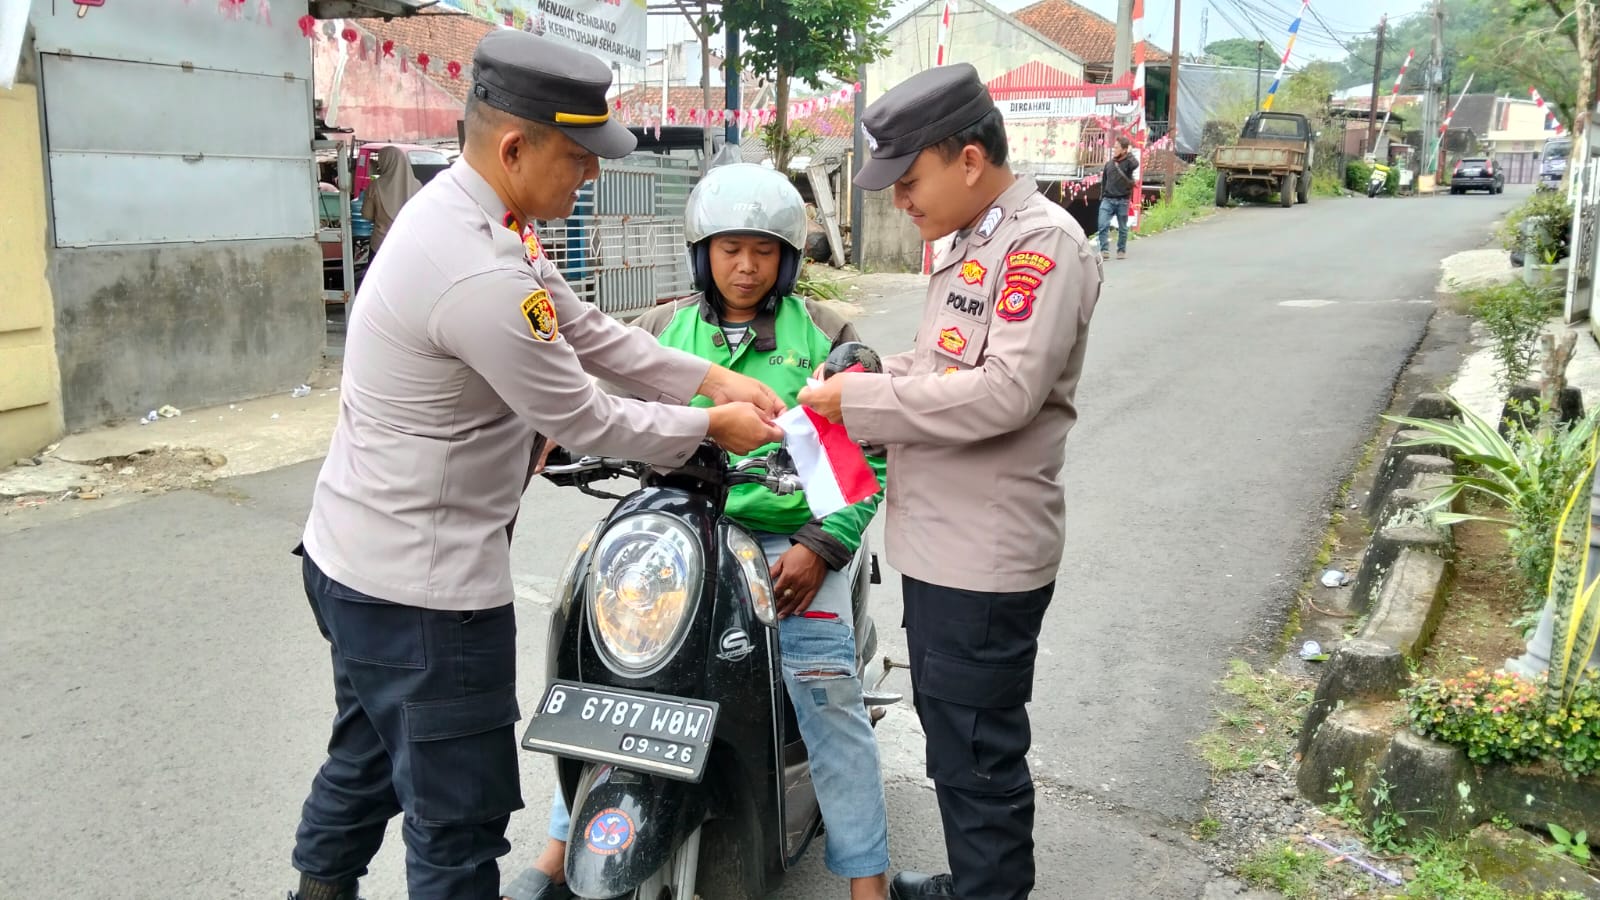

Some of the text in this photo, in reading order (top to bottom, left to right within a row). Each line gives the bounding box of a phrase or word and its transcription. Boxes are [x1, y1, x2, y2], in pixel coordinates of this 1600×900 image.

[538, 0, 617, 34] MENJUAL SEMBAKO
[548, 20, 598, 47] KEBUTUHAN
[598, 36, 641, 62] SEHARI-HARI
[1009, 253, 1051, 267] POLRES
[947, 292, 984, 316] POLRI
[768, 355, 784, 366] GO
[547, 690, 567, 714] B
[581, 696, 645, 729] 6787
